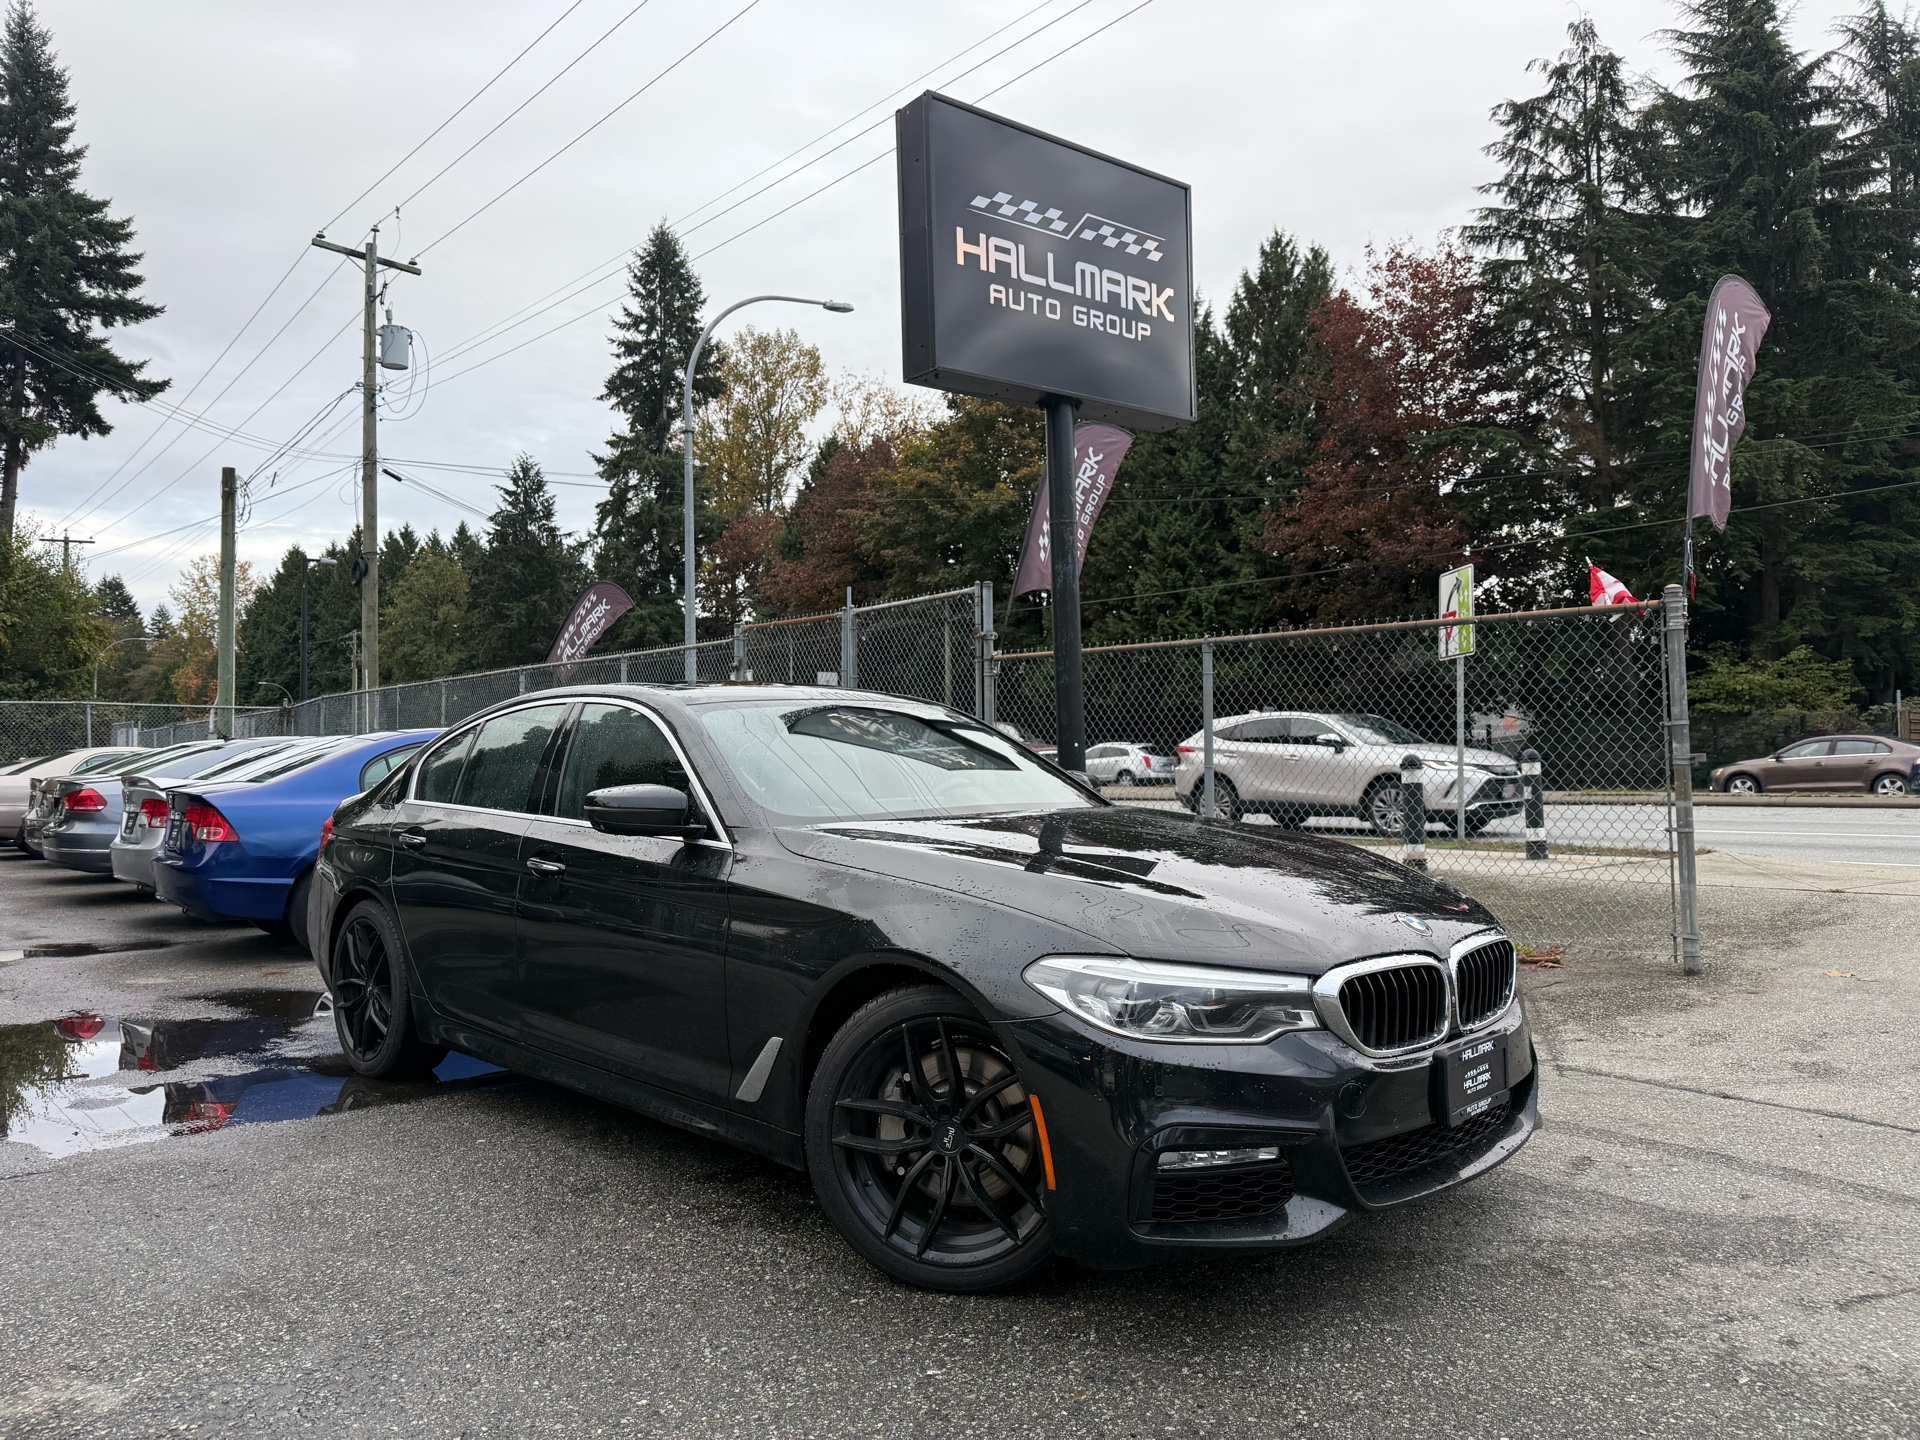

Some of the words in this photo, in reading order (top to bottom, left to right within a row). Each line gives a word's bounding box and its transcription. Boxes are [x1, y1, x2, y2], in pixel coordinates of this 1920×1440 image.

[956, 226, 1175, 322] HALLMARK
[989, 283, 1061, 320] AUTO
[1072, 304, 1151, 341] GROUP
[1726, 355, 1746, 426] GRP
[1081, 473, 1106, 525] GROUP
[1461, 1040, 1495, 1062] HALLMARK
[1463, 1071, 1492, 1090] HALLMARK
[1466, 1103, 1478, 1114] AUTO
[1477, 1097, 1492, 1108] GROUP
